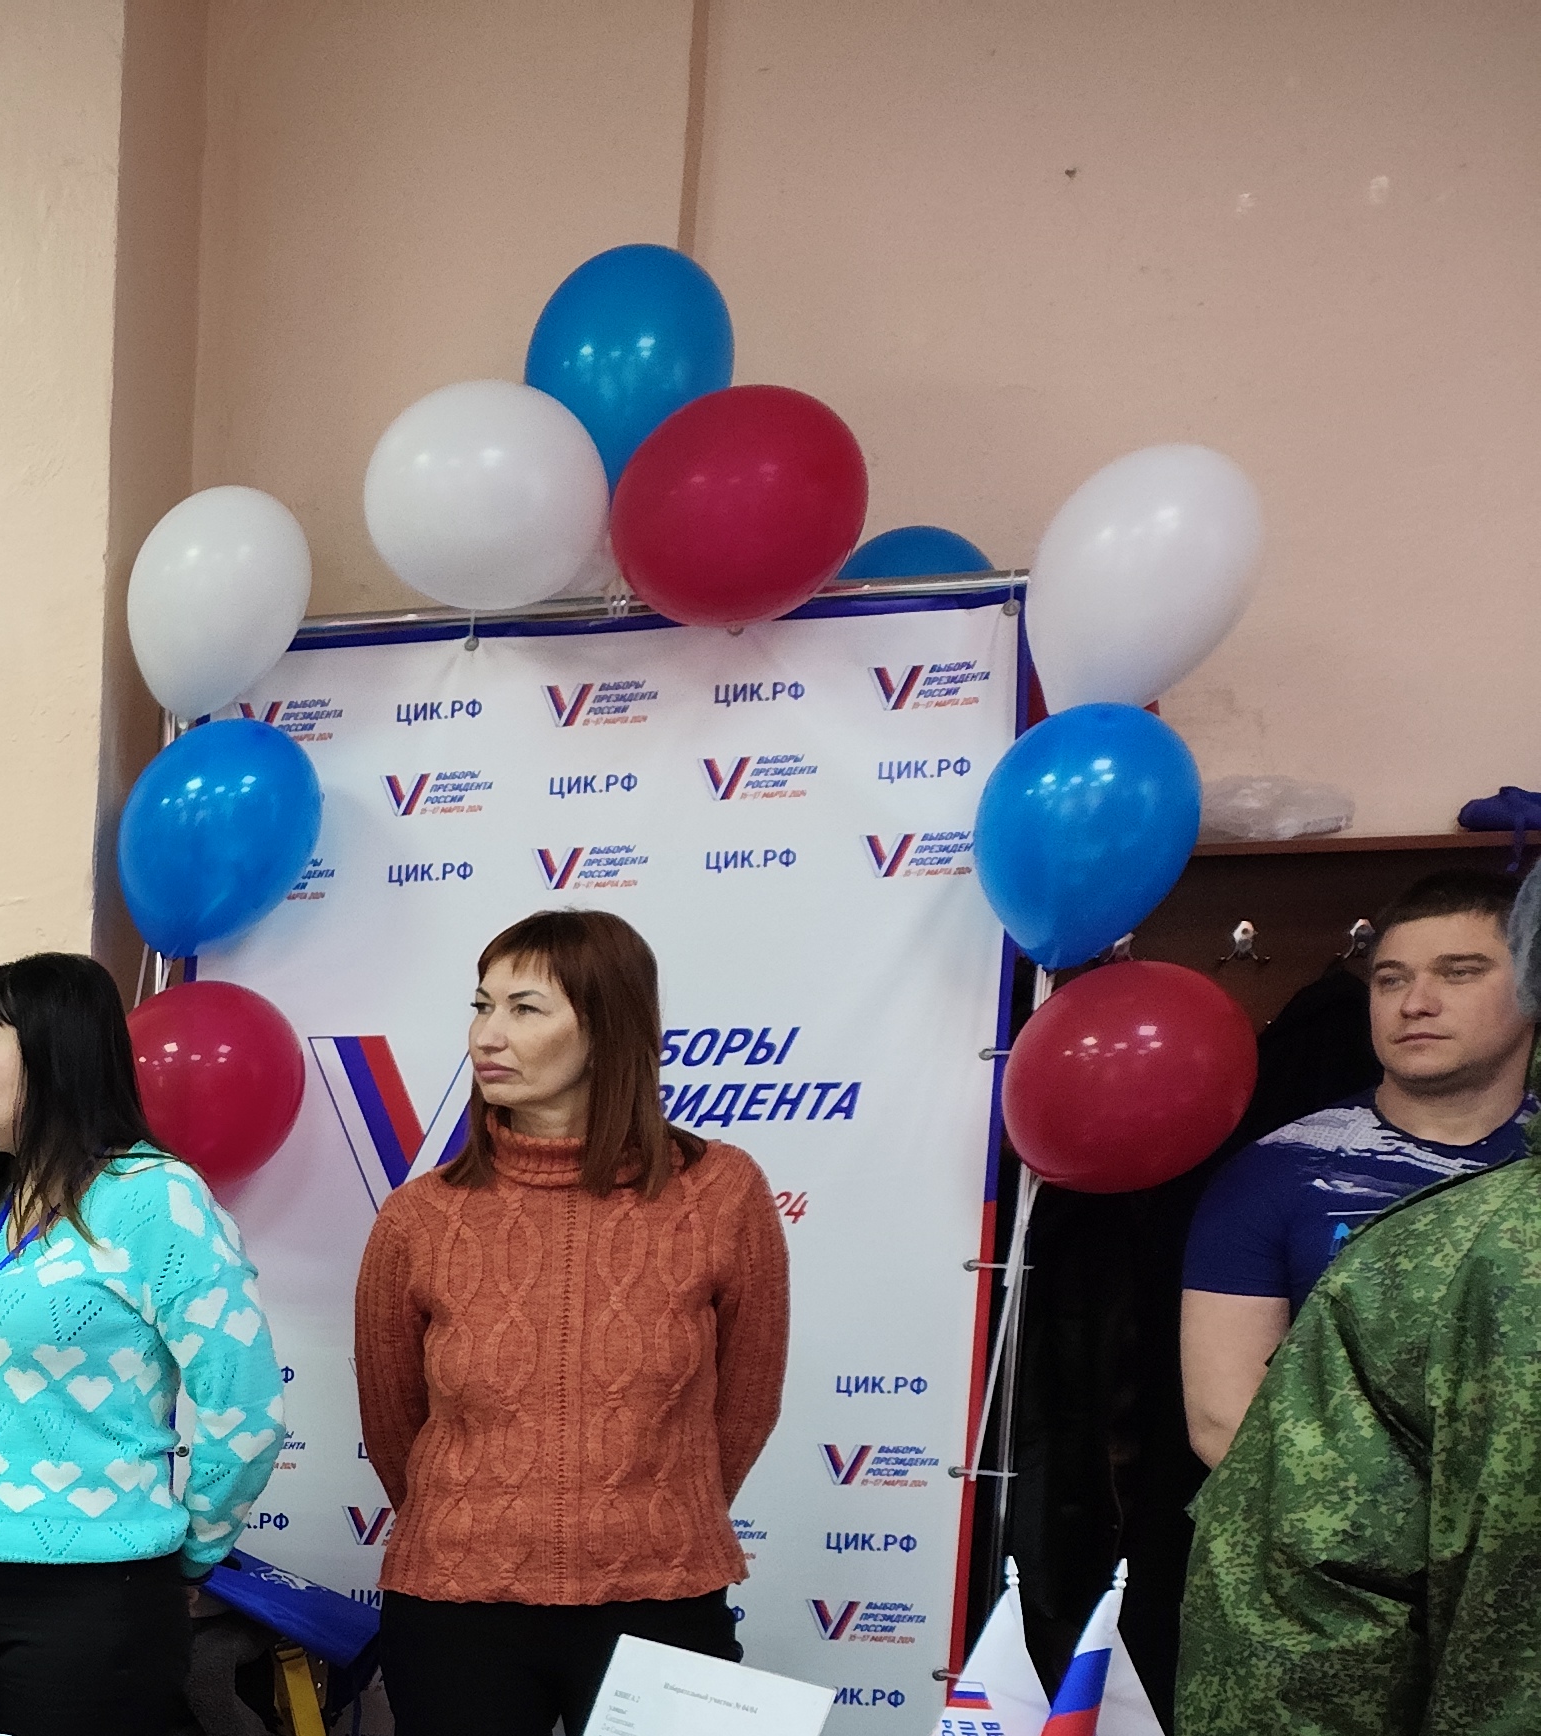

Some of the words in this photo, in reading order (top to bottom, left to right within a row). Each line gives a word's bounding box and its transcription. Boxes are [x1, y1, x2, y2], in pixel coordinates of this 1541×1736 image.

[929, 660, 977, 673] ВЫБОРЫ
[923, 671, 991, 686] ПРЕЗИДЕНТА
[714, 680, 805, 707] ЦИК.РФ
[916, 687, 960, 698] РОССИИ
[396, 698, 483, 725] ЦИК.РФ
[756, 754, 805, 764] ВЫБОРЫ
[436, 770, 481, 781] ВЫБОРЫ
[750, 765, 818, 777] ПРЕЗИДЕНТА
[878, 756, 971, 783] ЦИК.РФ
[430, 781, 493, 793] ПРЕЗИДЕНТА
[549, 773, 638, 798] ЦИК.РФ
[744, 779, 788, 789] РОССИИ
[424, 794, 465, 805] РОССИИ
[921, 831, 971, 841] ВЫБОРЫ
[914, 842, 974, 854] ПРЕЗИДЕН
[705, 848, 797, 873] ЦИК.РФ
[908, 856, 953, 866] РОССИИ
[388, 861, 474, 886] ЦИК.РФ
[577, 869, 620, 878] РОССИИ
[659, 1026, 801, 1067] БОРЫ
[659, 1081, 862, 1128] ЗИДЕНТА
[775, 1191, 809, 1225] 24
[836, 1375, 928, 1397] ЦИК.РФ
[878, 1445, 926, 1454] ВЫБОРЫ
[871, 1457, 939, 1467] ПРЕЗИДЕНТА
[865, 1468, 909, 1476] РОССИИ
[826, 1532, 917, 1554] ЦИК.РФ
[865, 1601, 914, 1612] ВЫБОРЫ
[859, 1612, 926, 1623] ПРЕЗИДЕНТА
[853, 1623, 896, 1633] РОССИИ
[833, 1687, 905, 1708] ИК.РФ
